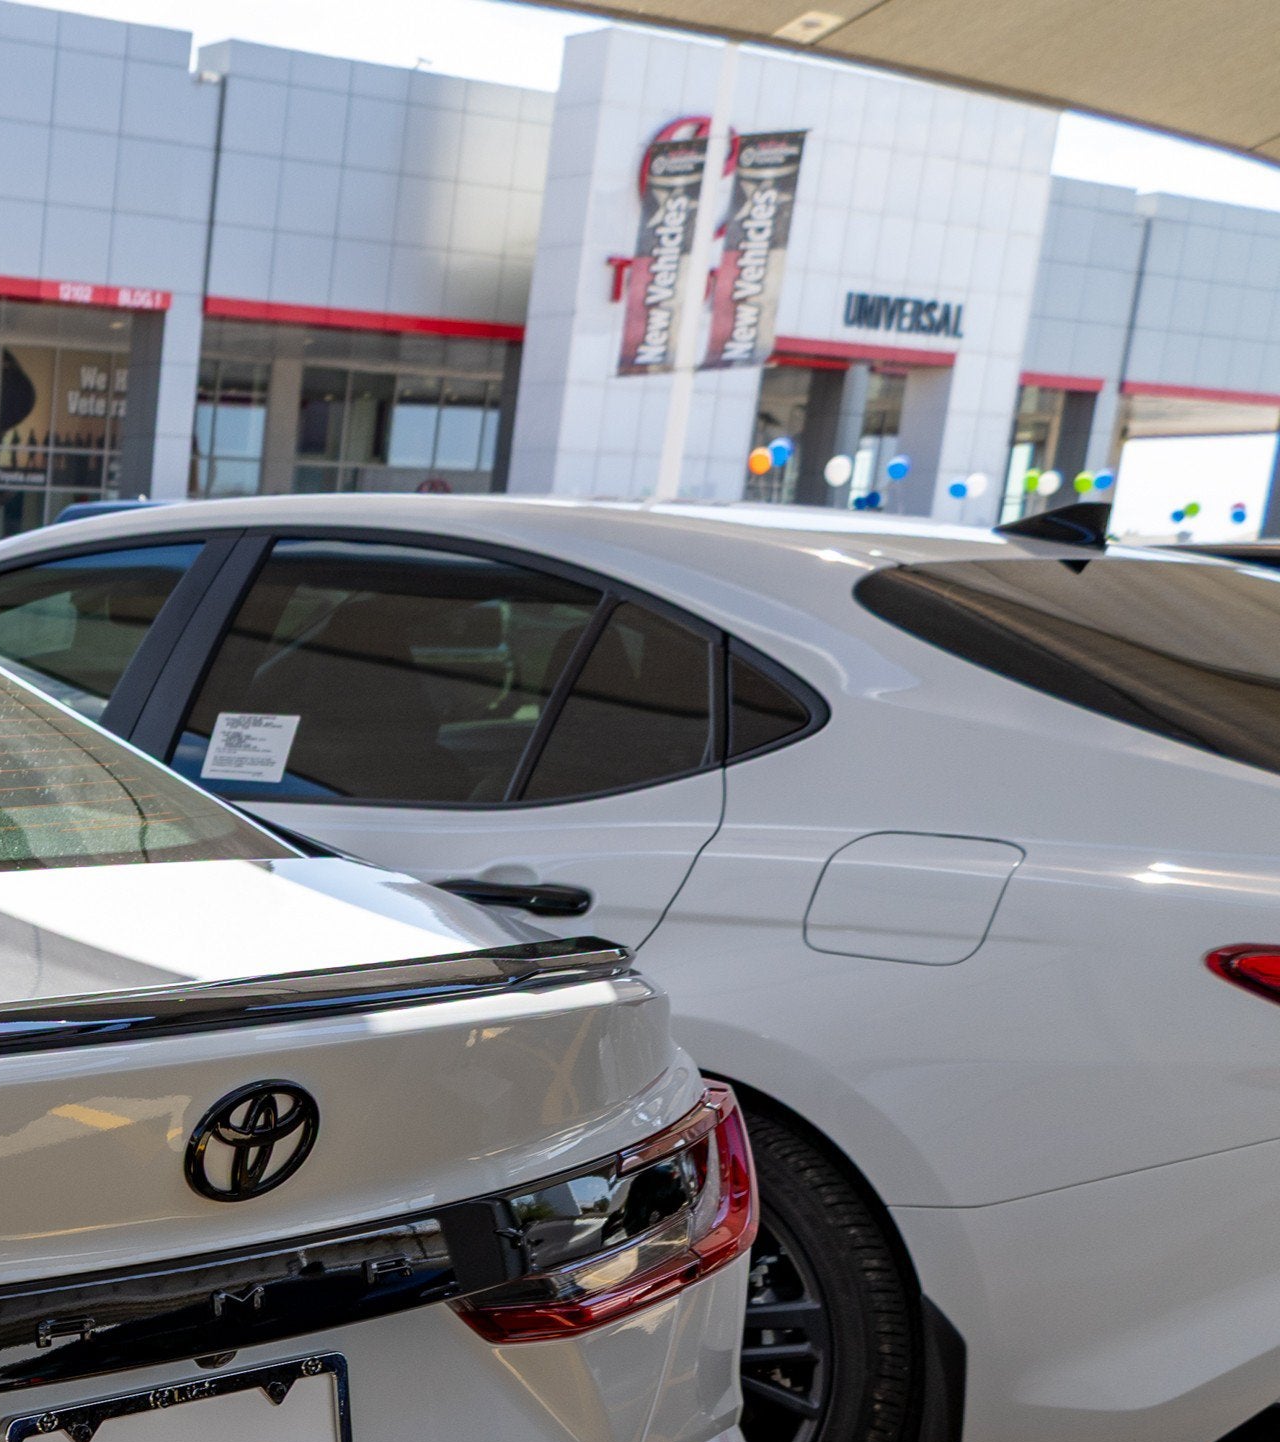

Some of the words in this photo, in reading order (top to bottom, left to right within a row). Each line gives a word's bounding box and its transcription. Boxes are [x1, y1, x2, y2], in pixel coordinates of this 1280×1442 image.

[645, 196, 689, 305] Vehicles
[733, 188, 778, 301] Vehicles
[634, 308, 671, 364] New
[721, 303, 760, 361] New
[844, 291, 964, 339] UNIVERSAL
